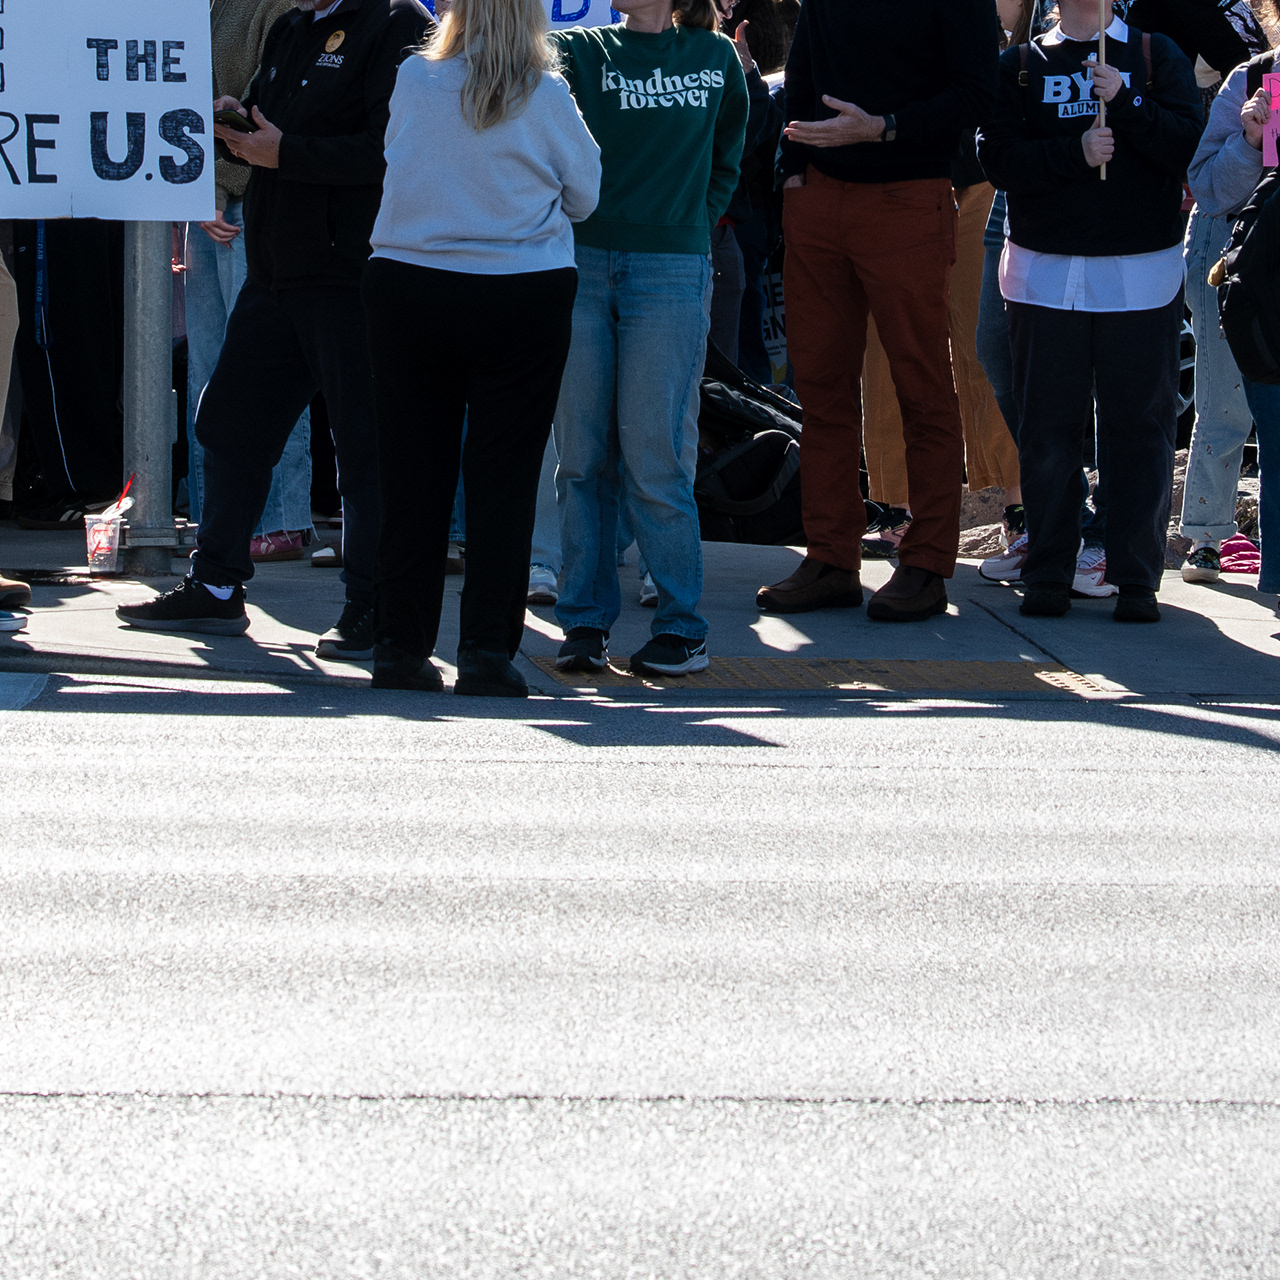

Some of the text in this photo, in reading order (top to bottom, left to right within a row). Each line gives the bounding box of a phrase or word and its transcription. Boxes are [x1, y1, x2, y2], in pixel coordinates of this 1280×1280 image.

[86, 36, 188, 84] THE
[318, 53, 345, 64] ZIONS
[601, 62, 725, 95] kindness
[1041, 71, 1133, 103] BY
[619, 88, 709, 110] forever
[1062, 102, 1103, 117] ALUM
[89, 108, 206, 185] U.S
